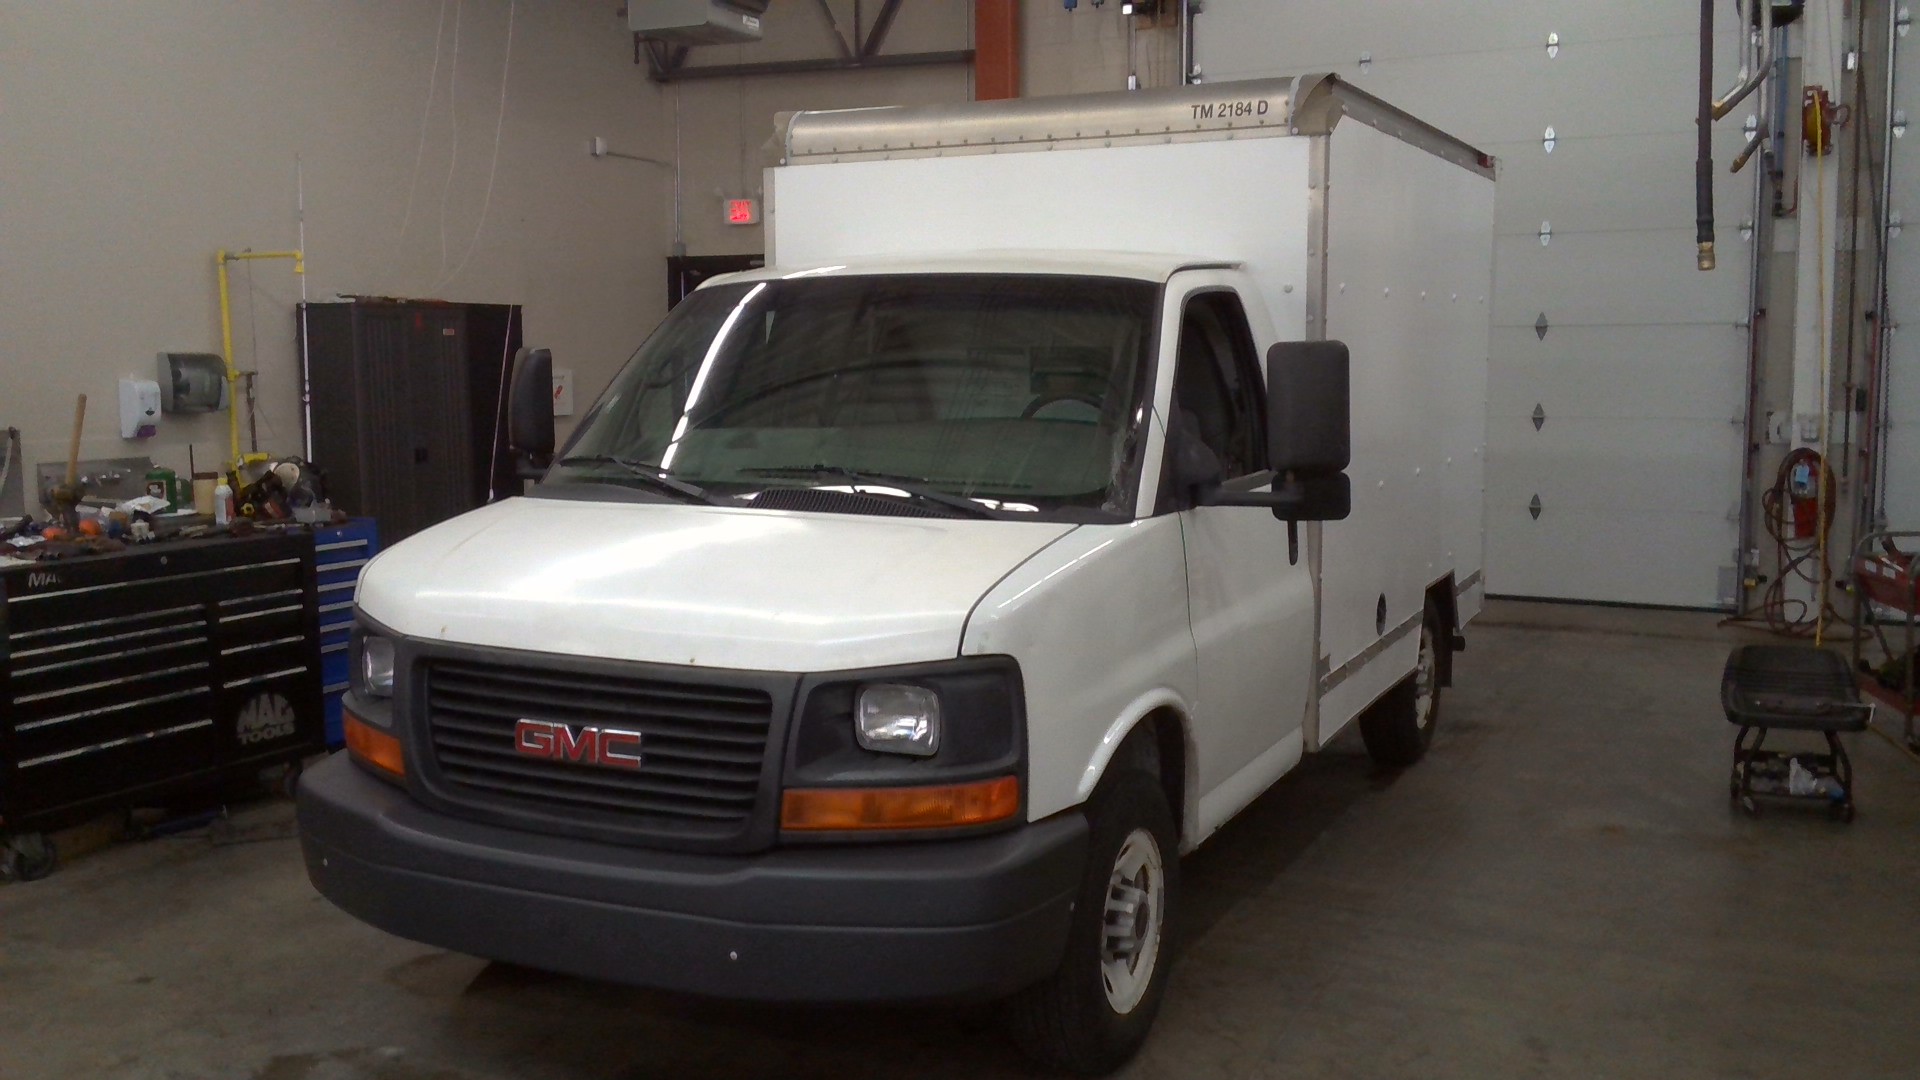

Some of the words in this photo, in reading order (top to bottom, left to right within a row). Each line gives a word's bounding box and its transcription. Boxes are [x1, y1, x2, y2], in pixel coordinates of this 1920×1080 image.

[1191, 103, 1214, 119] TM
[1217, 101, 1252, 118] 2184
[1257, 100, 1269, 115] D
[28, 572, 62, 588] MA
[236, 693, 295, 732] MAC
[514, 718, 642, 768] GMC
